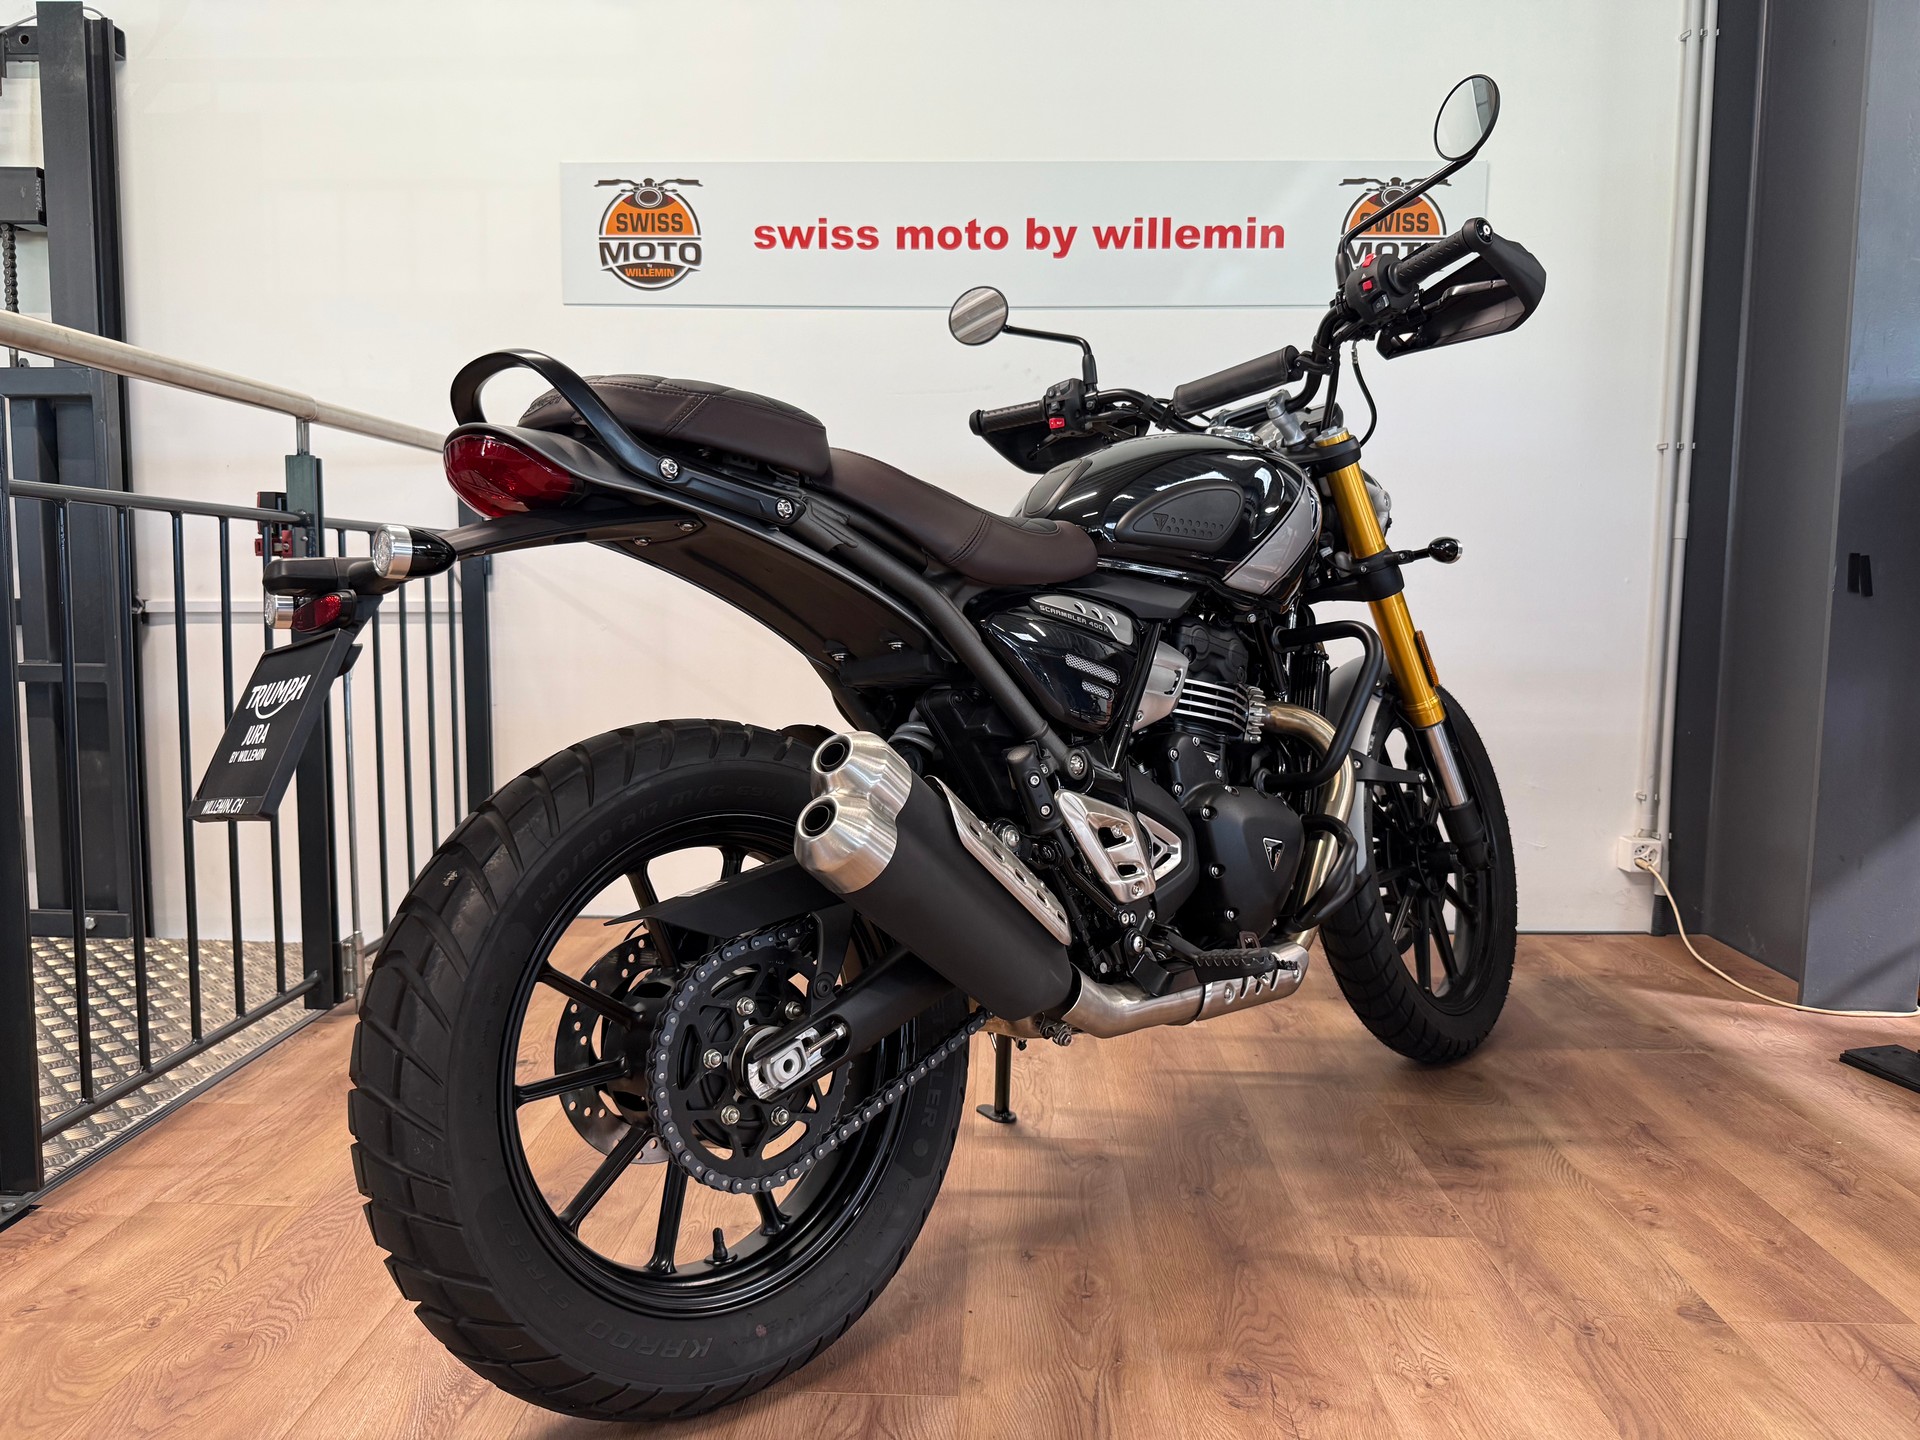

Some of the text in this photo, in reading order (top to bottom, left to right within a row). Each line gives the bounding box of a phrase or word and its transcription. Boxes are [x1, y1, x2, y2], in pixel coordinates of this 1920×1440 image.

[615, 213, 684, 232] SWISS
[754, 217, 1285, 259] swiss moto by willemin
[600, 242, 701, 265] MOTO
[1349, 243, 1436, 264] MOT
[625, 268, 675, 277] WILLEMIN
[1039, 605, 1087, 625] SCRAMBLER
[245, 674, 311, 719] TRIUMPH
[241, 723, 270, 746] JURA
[228, 748, 267, 764] BY WILLEMIN
[200, 798, 246, 815] WILLEMIN.CH
[583, 1319, 713, 1359] KAROO
